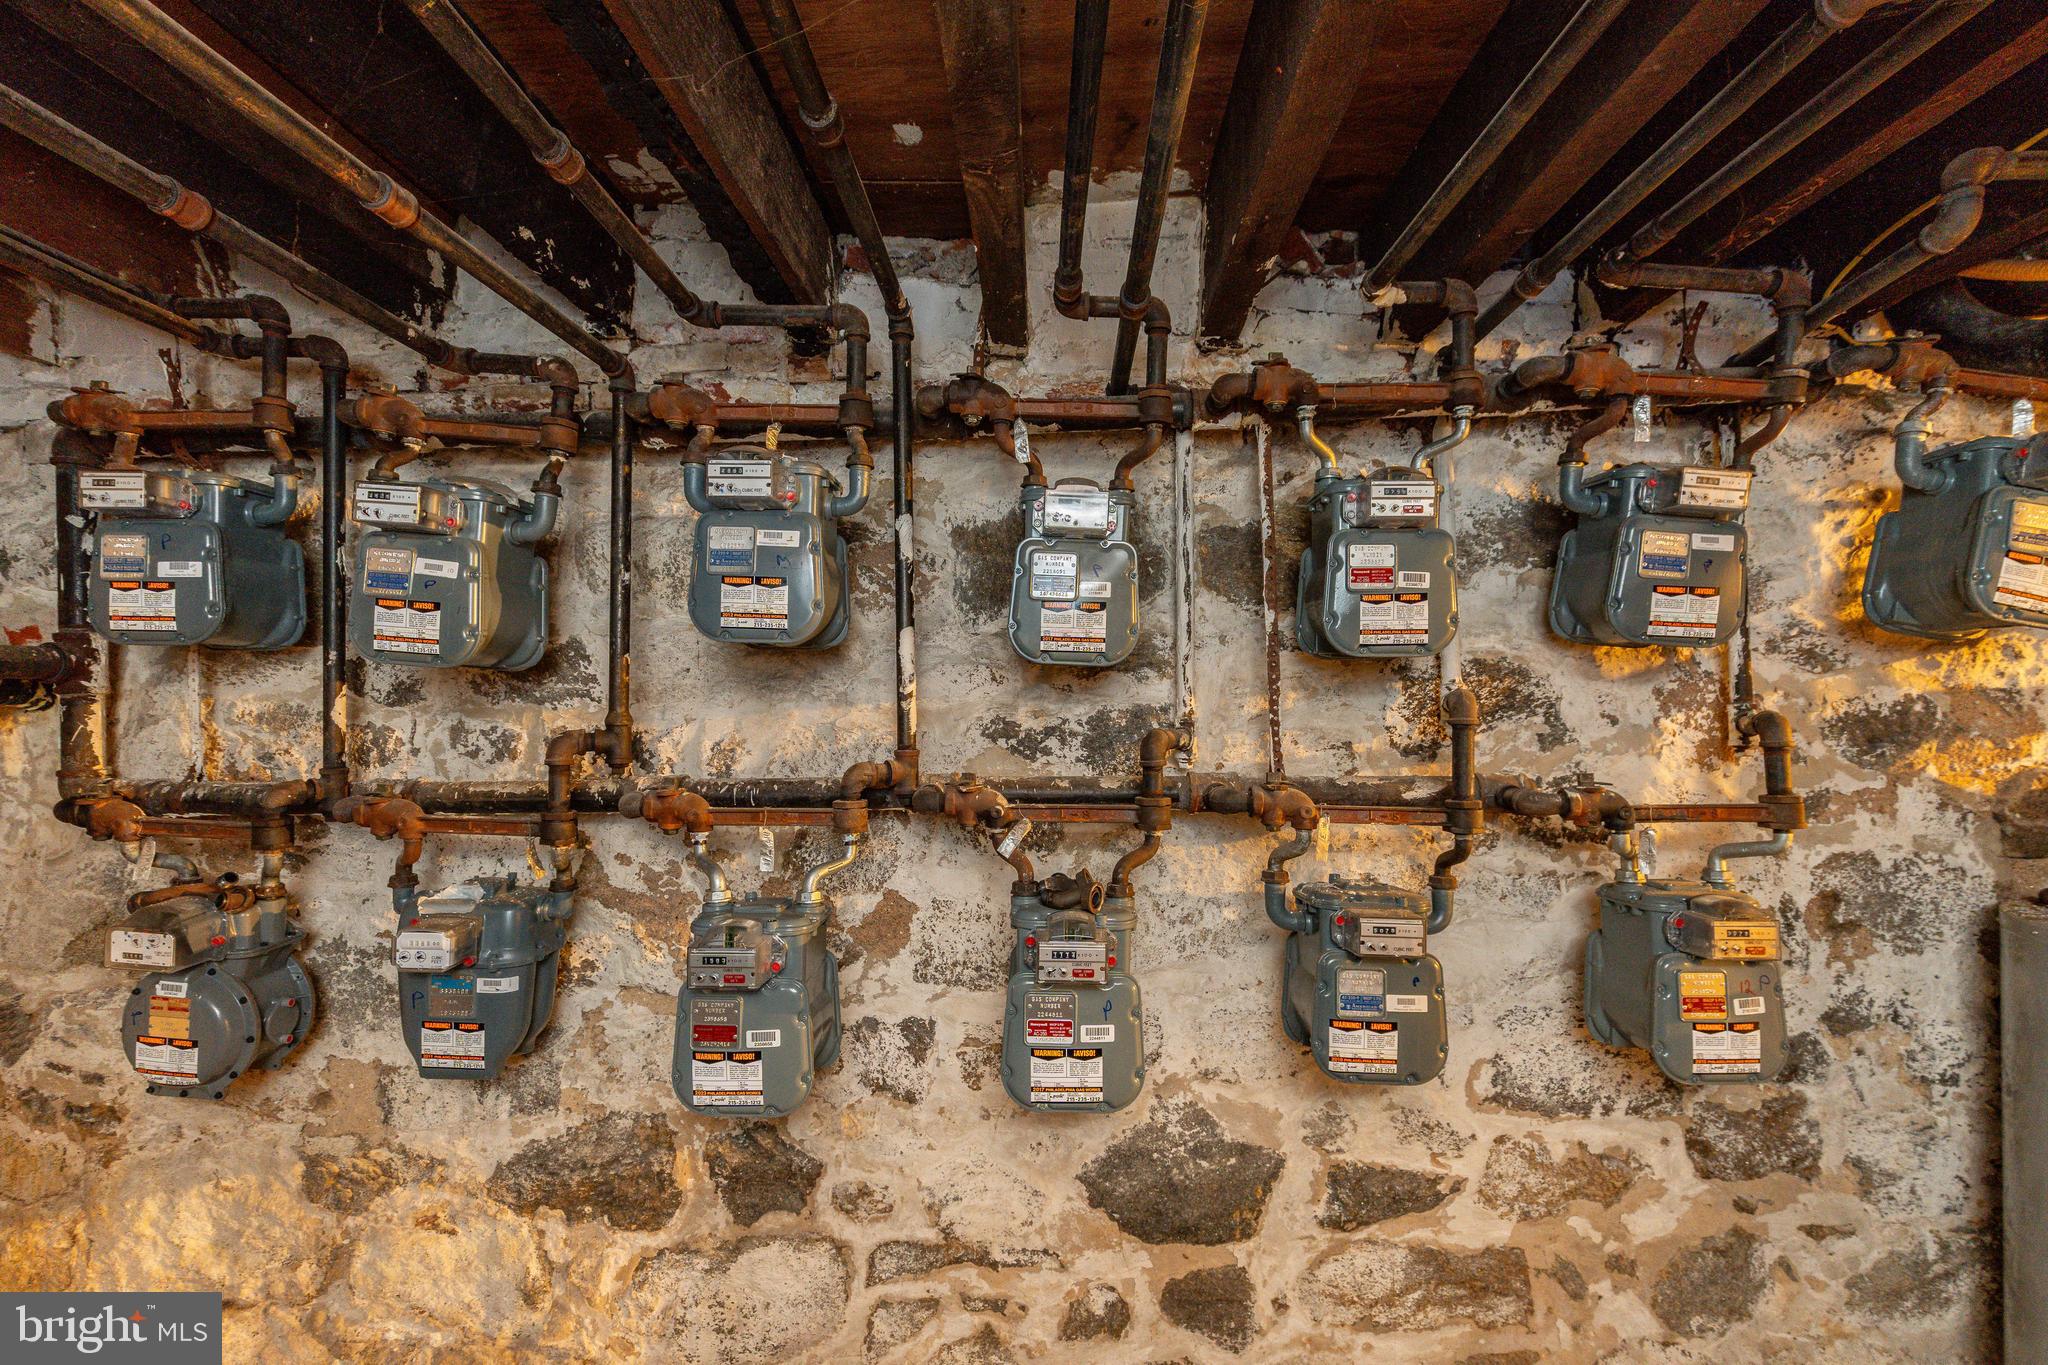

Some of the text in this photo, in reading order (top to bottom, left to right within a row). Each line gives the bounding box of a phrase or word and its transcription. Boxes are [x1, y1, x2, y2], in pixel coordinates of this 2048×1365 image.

[161, 534, 171, 549] P
[425, 580, 436, 589] P
[1759, 975, 1770, 991] P
[412, 991, 424, 1009] P
[1103, 1000, 1112, 1021] P
